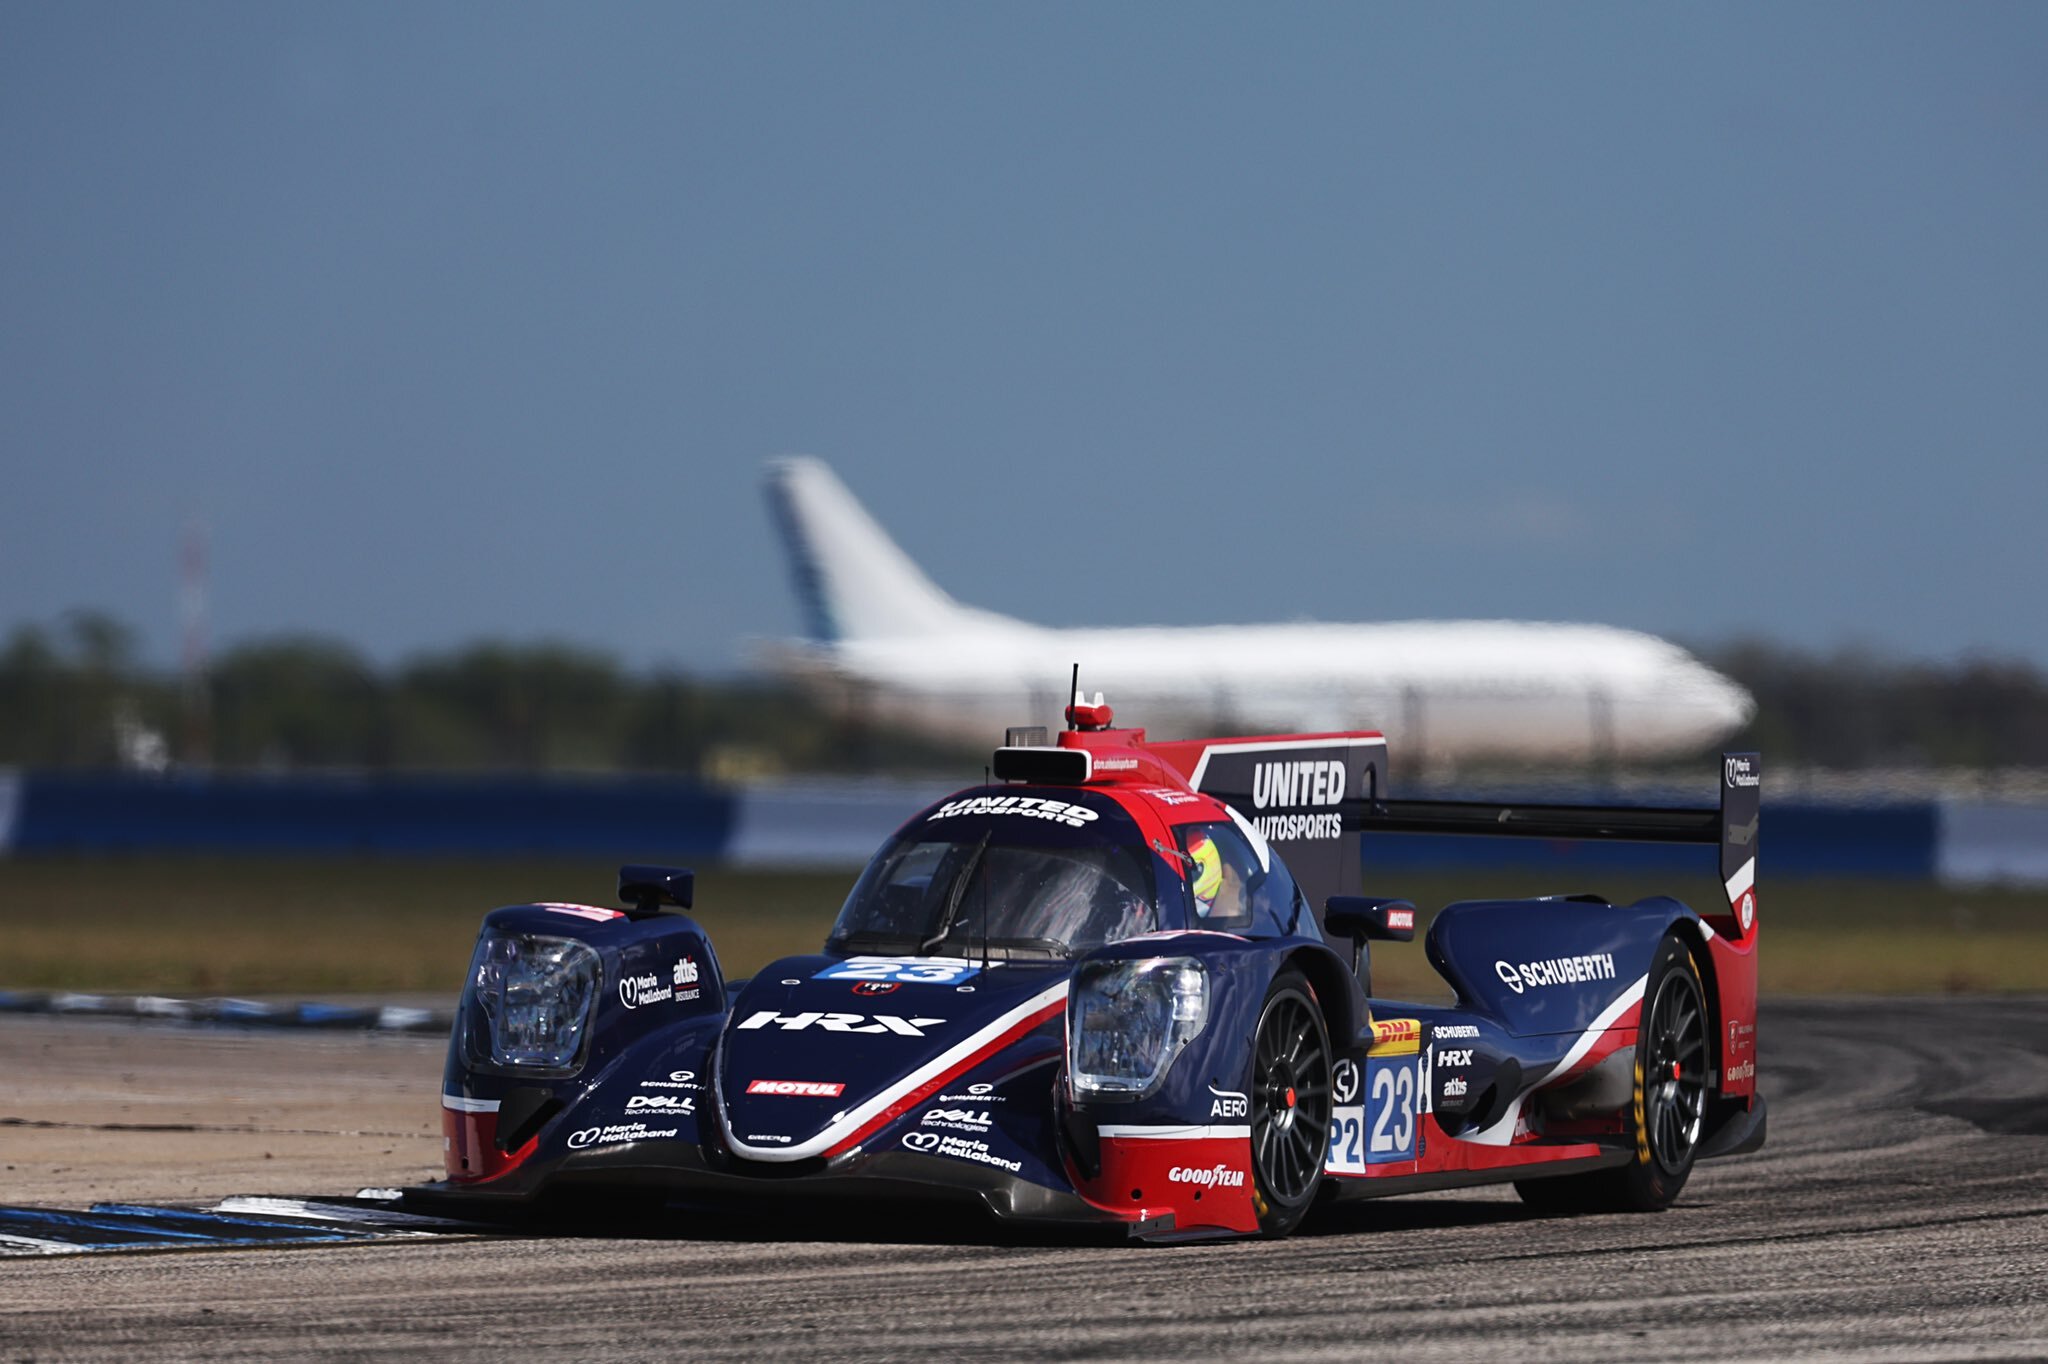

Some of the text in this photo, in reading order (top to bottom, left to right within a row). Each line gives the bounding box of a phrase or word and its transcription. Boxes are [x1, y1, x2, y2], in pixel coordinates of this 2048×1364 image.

[1253, 760, 1346, 809] UNITED
[927, 807, 1085, 828] AUTOSPORTS
[939, 797, 1099, 821] UNITED
[1252, 813, 1342, 841] AUTOSPORTS
[673, 953, 699, 984] attis
[829, 963, 963, 982] 23
[1518, 953, 1616, 987] SCHUBERTH
[637, 971, 657, 990] Maria
[638, 984, 672, 1005] Mallaband
[675, 988, 700, 1002] INSURANCE
[737, 1011, 948, 1036] HRX
[1377, 1021, 1414, 1043] DHL
[1434, 1025, 1480, 1039] SCHUBERTH
[1437, 1049, 1474, 1067] HRX
[640, 1081, 706, 1091] SCHUBERTH
[751, 1081, 838, 1096] MOTUL
[1443, 1075, 1468, 1096] attis
[626, 1095, 696, 1111] DELL
[939, 1094, 1007, 1103] SCHUBERTH
[1210, 1099, 1248, 1117] AERO
[624, 1108, 692, 1116] Technologies
[922, 1108, 993, 1125] DELL
[1370, 1066, 1414, 1153] 23
[598, 1128, 678, 1143] Mallaband
[602, 1122, 647, 1135] Maria
[920, 1119, 989, 1133] Technologies
[941, 1135, 989, 1152] Maria
[937, 1144, 1022, 1172] Mallaband
[1168, 1163, 1245, 1190] GOODYEAR
